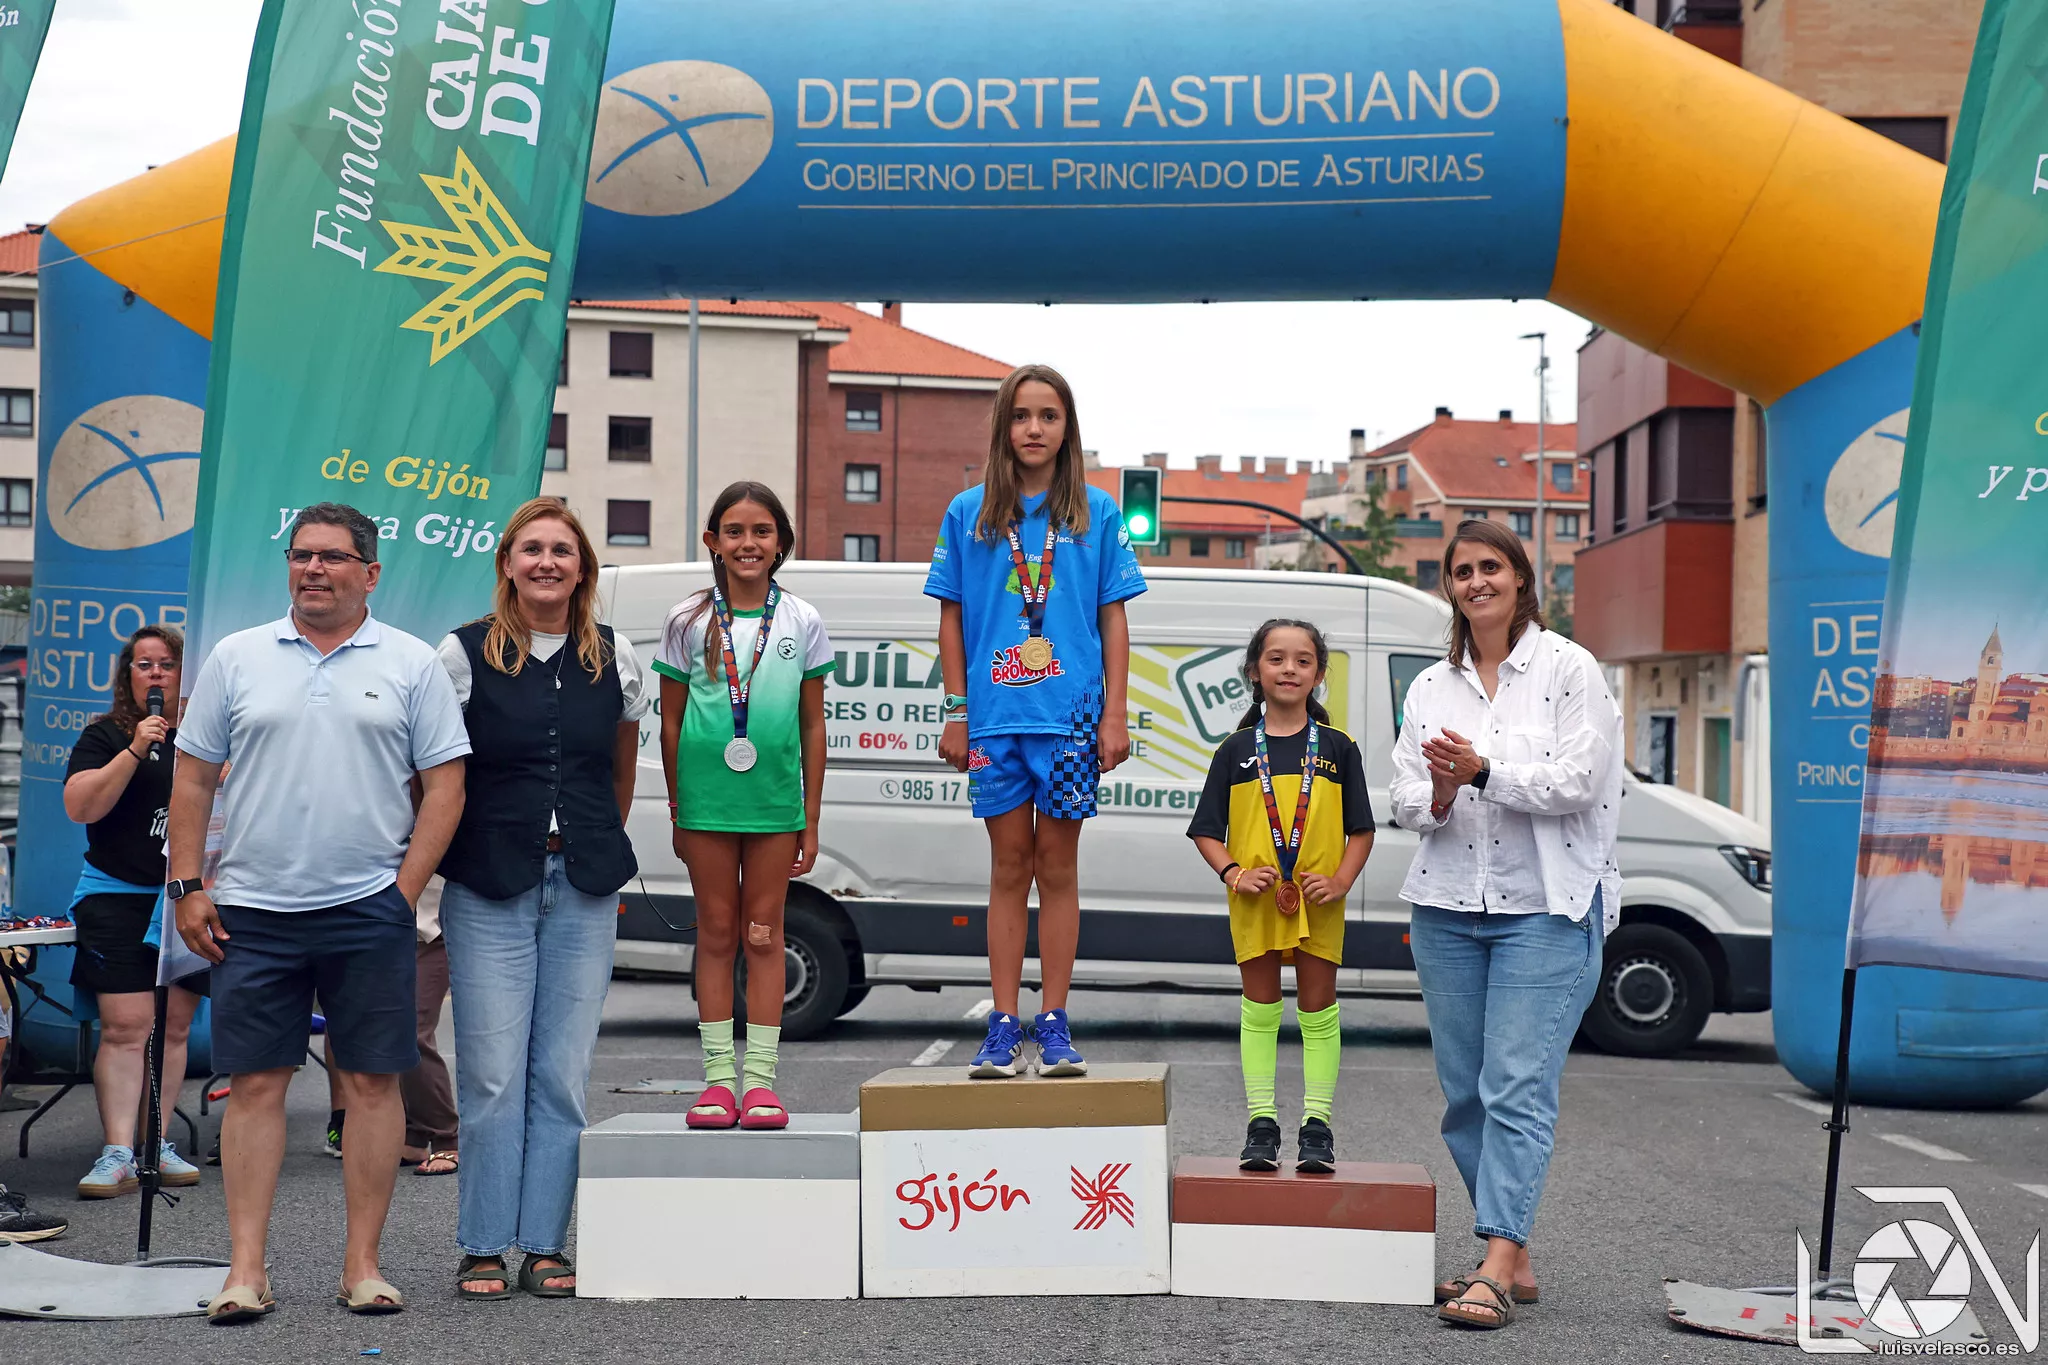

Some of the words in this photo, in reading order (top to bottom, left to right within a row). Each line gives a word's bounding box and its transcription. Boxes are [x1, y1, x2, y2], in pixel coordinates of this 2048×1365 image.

[480, 25, 550, 146] DE
[797, 77, 1100, 130] DEPORTE
[1122, 66, 1501, 128] ASTURIANO
[312, 0, 401, 270] Fundació
[803, 159, 976, 191] GOBIERNO
[984, 164, 1044, 191] DEL
[1052, 158, 1248, 190] PRINCIPADO
[1257, 160, 1300, 188] DE
[1313, 153, 1485, 188] ASTURIAS
[321, 448, 370, 483] de
[385, 456, 491, 500] Gijón
[1978, 465, 2015, 498] y
[415, 513, 503, 558] Gijó
[859, 732, 908, 750] 60%
[902, 779, 933, 801] 985
[941, 781, 961, 801] 17
[896, 1169, 1031, 1232] gijón
